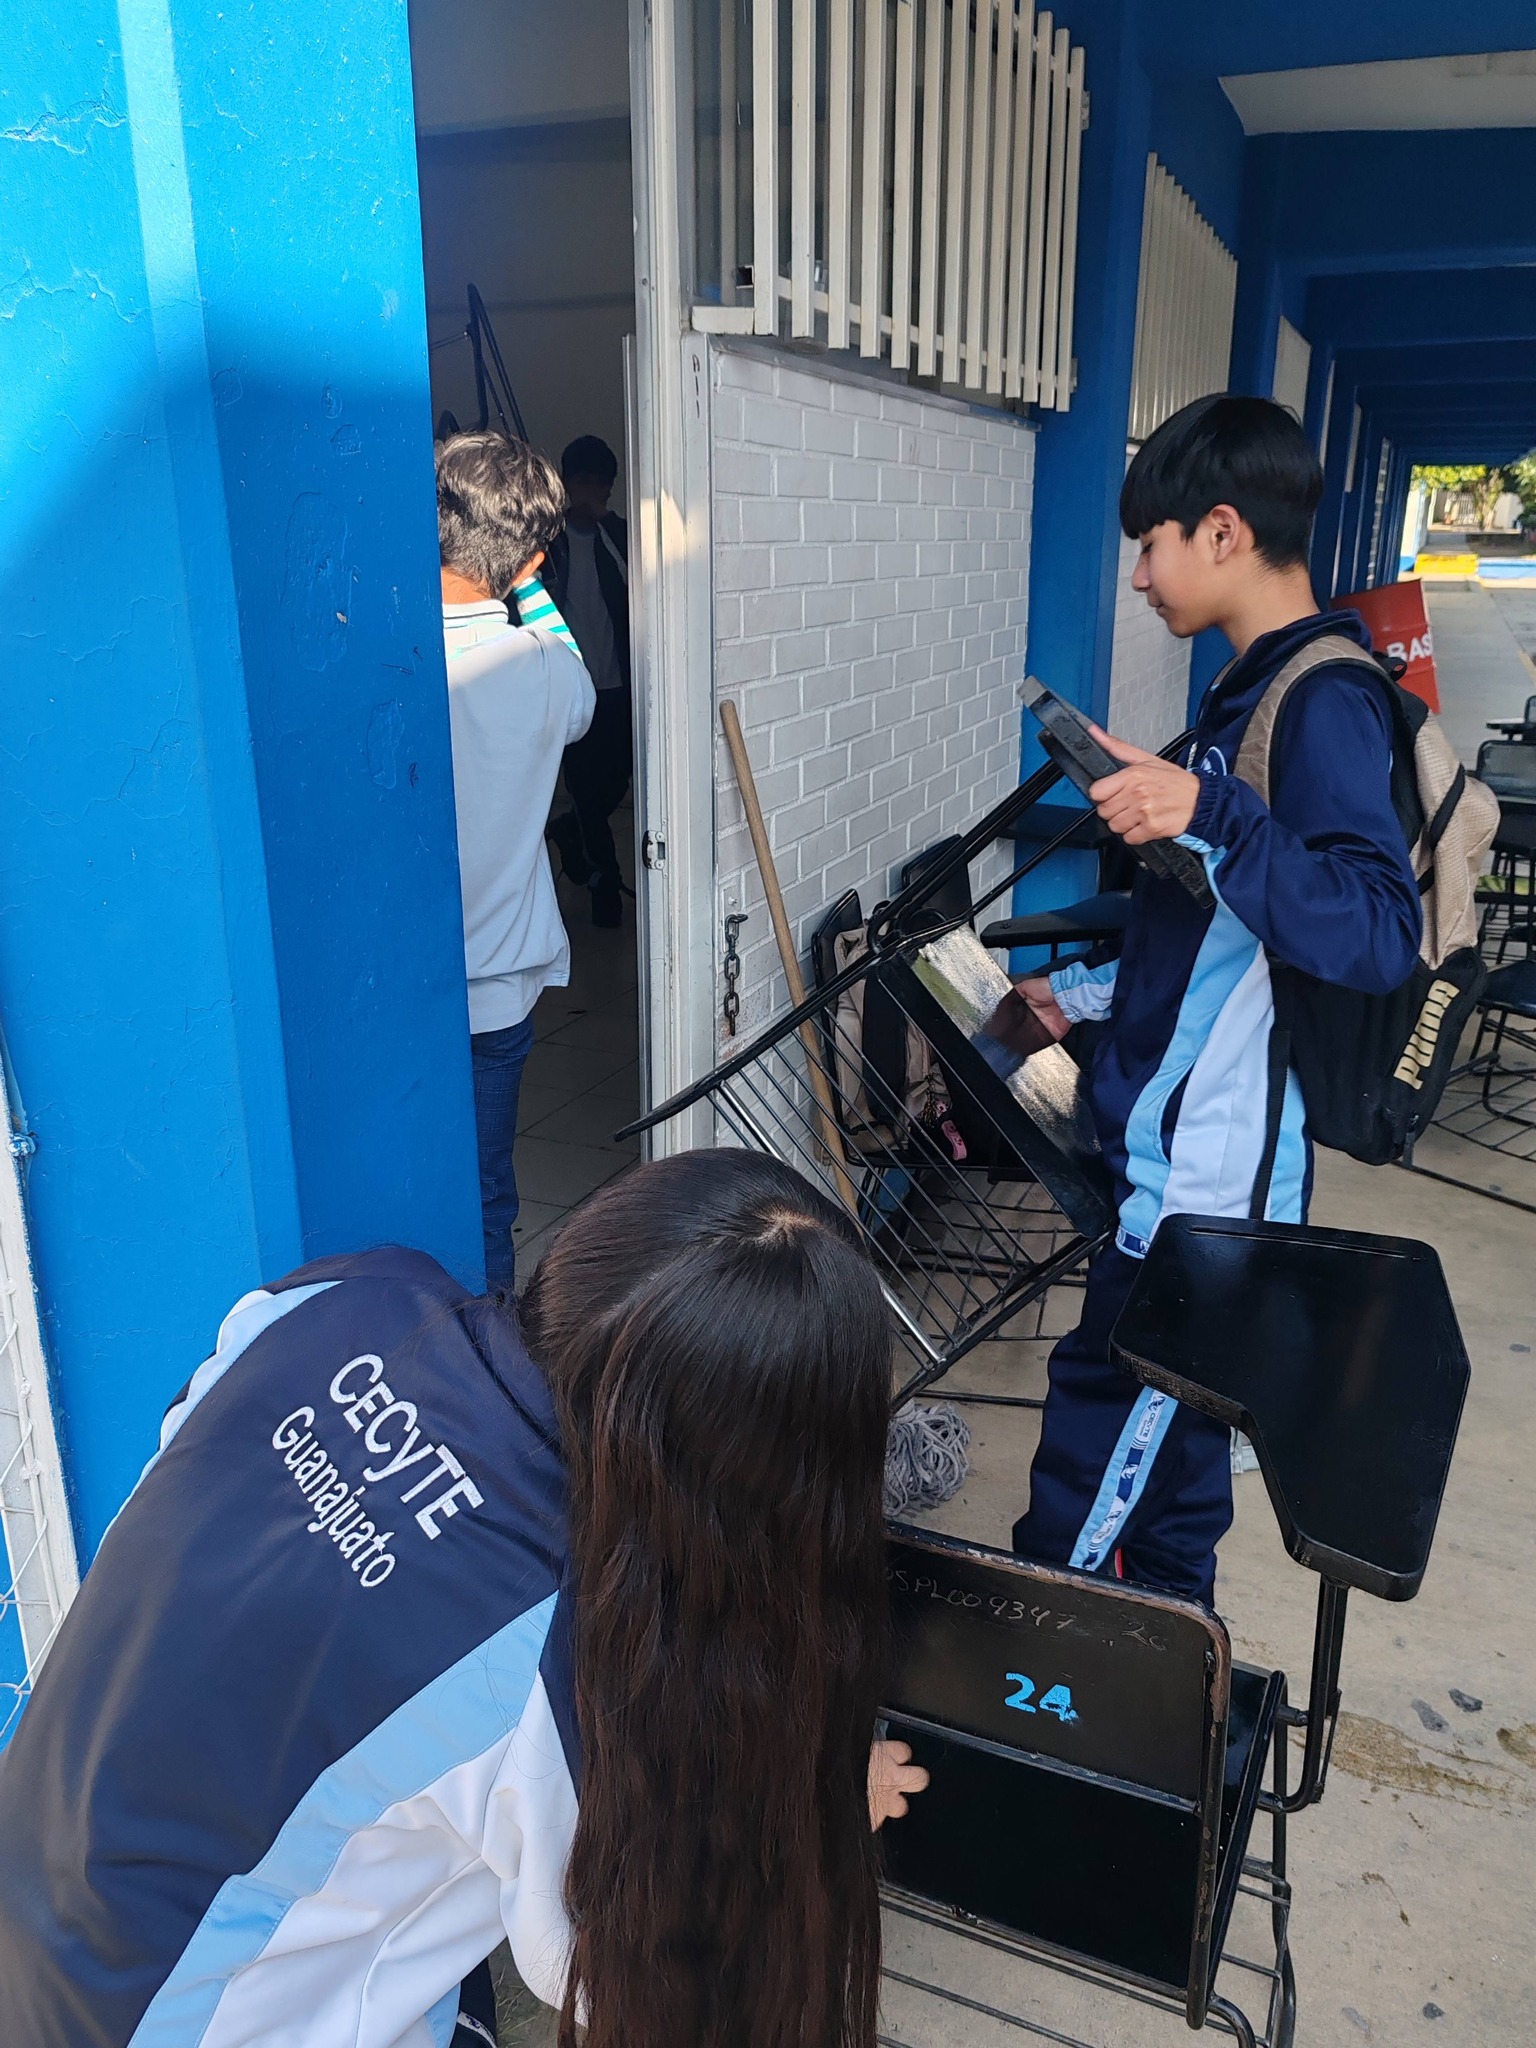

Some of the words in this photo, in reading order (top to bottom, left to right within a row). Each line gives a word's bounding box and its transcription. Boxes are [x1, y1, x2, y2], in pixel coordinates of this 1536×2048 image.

[1393, 979, 1460, 1090] PUMA
[271, 1405, 396, 1588] Guanajuato
[1004, 1672, 1079, 1725] 24
